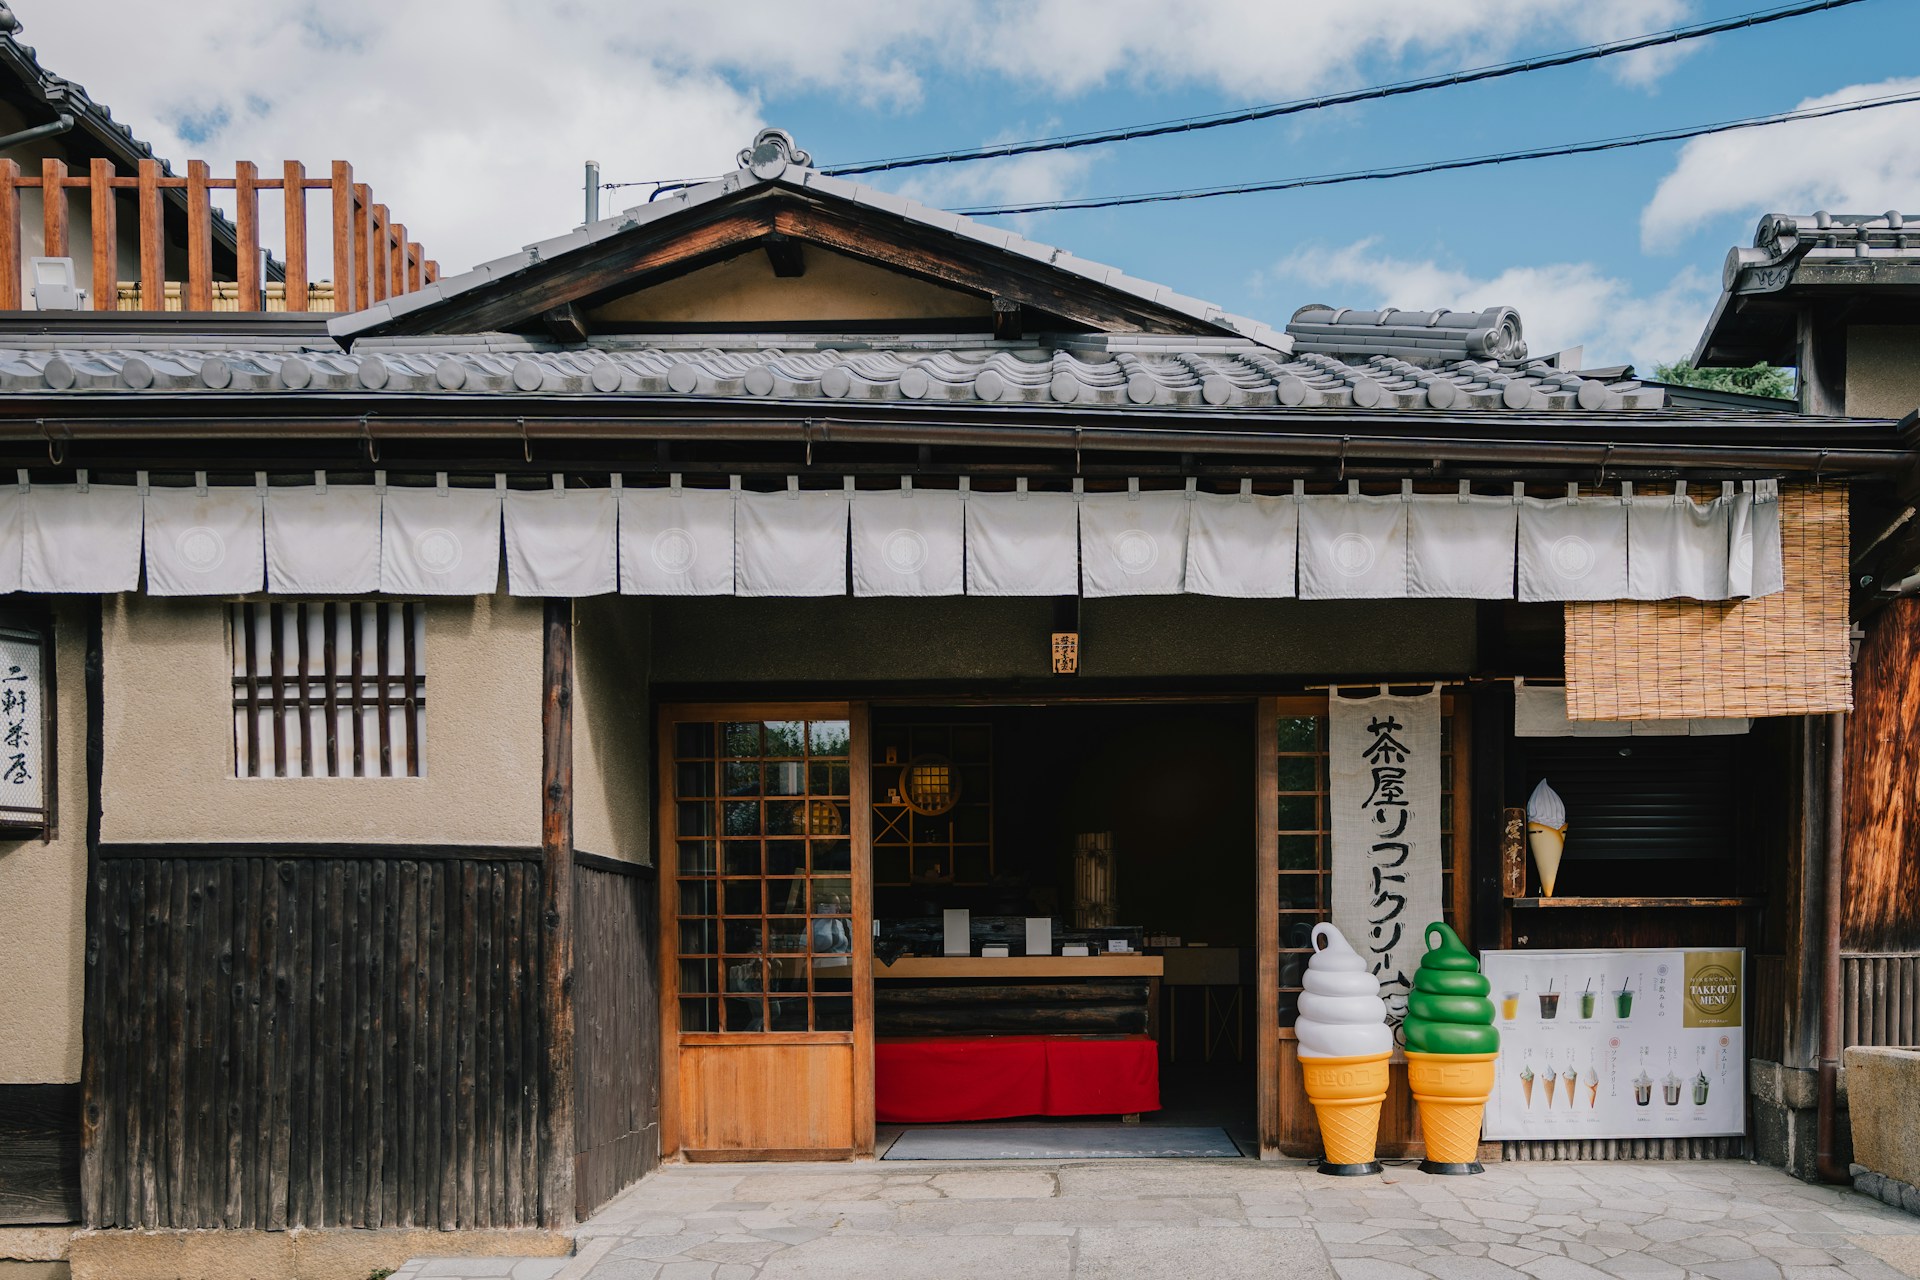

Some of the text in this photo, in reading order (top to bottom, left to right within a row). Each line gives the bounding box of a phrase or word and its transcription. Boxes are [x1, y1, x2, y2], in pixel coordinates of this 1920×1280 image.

[2, 665, 32, 785] 二軒茶屋
[1700, 995, 1728, 1005] MENU
